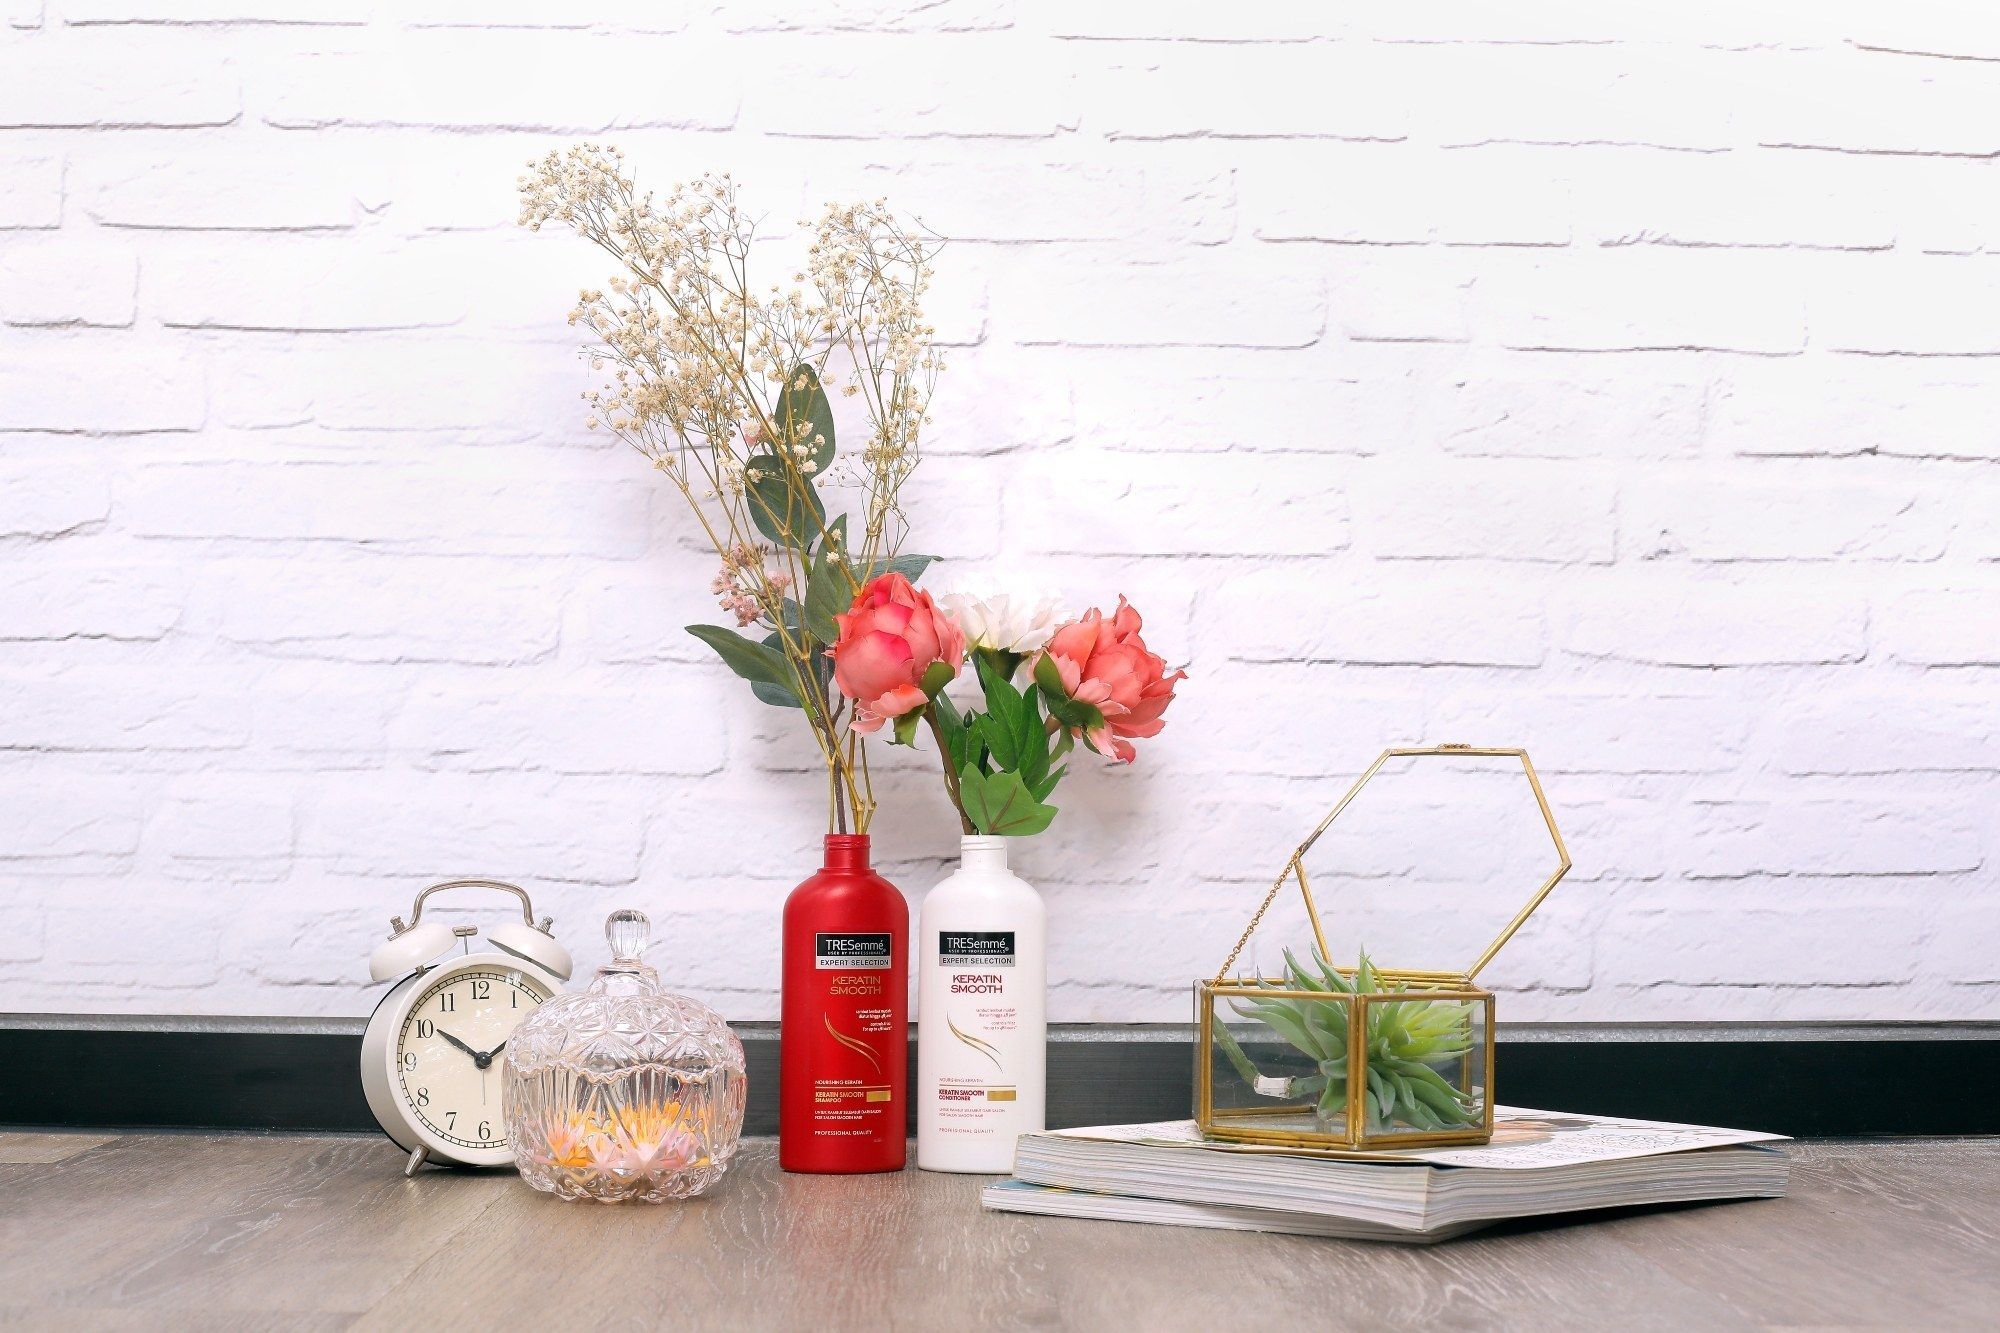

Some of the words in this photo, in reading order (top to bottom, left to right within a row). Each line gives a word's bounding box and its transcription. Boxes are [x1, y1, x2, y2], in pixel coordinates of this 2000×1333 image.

[826, 940, 884, 951] TRESemmé
[947, 938, 1006, 949] TRESemmé
[832, 976, 881, 985] KERATIN
[952, 975, 1002, 983] KERATIN
[470, 981, 490, 1000] 12
[830, 986, 881, 995] SMOOTH
[951, 985, 1003, 993] SMOOTH
[440, 993, 455, 1012] 11
[511, 990, 517, 1009] 1
[416, 1019, 434, 1039] 10
[404, 1052, 417, 1072] 9
[417, 1087, 430, 1107] 8
[445, 1111, 457, 1131] 7
[478, 1121, 491, 1140] 6
